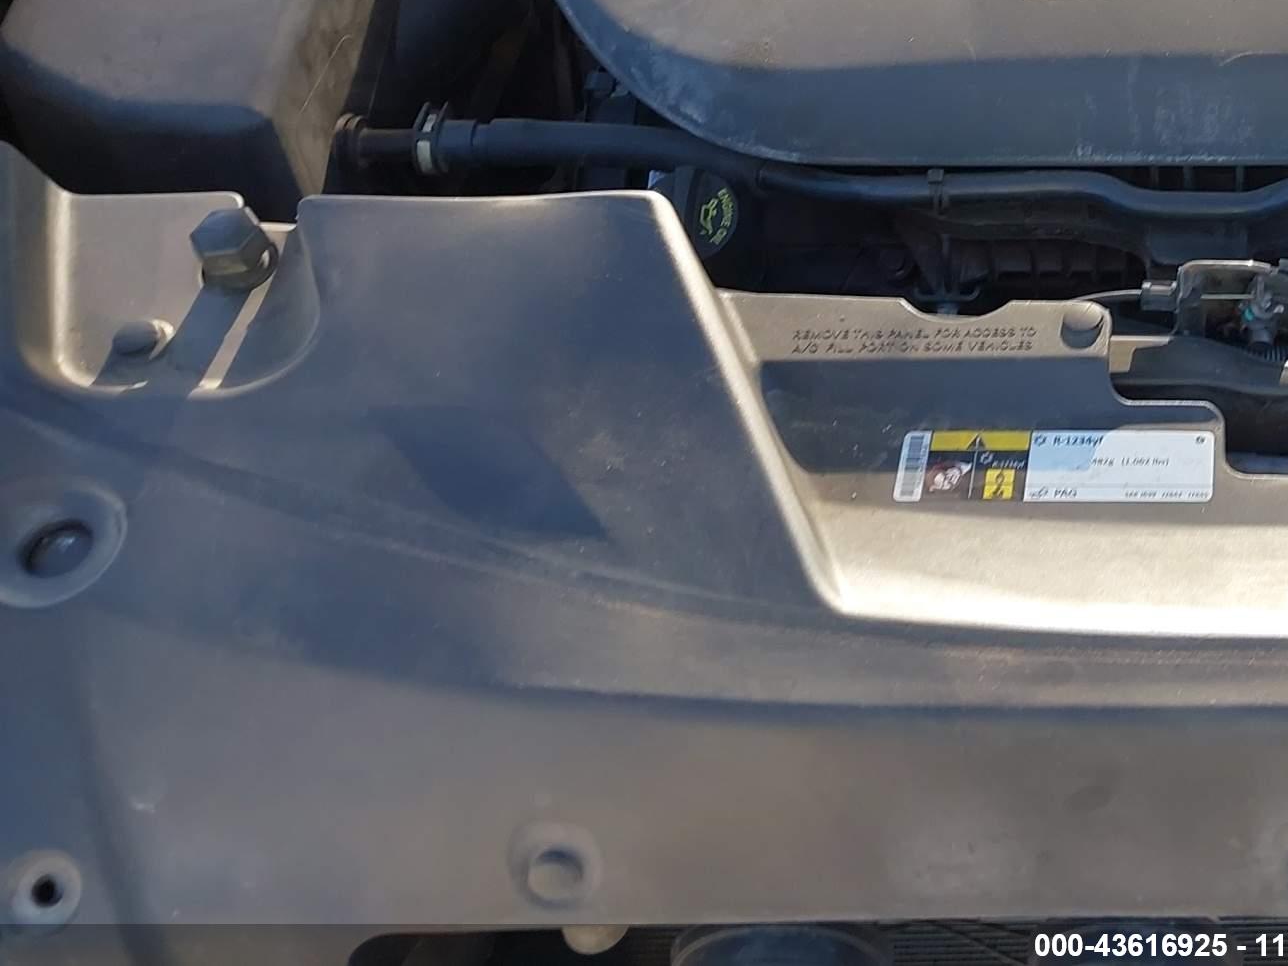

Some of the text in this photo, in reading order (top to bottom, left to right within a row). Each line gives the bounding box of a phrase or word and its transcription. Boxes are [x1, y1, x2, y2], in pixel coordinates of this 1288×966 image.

[708, 188, 734, 245] ENGINE OIL
[791, 326, 1038, 340] REMOVE THIS PANEL FOR ACCESS TO
[791, 340, 1033, 354] A/C FILL PORT ON SOME VEHICLES
